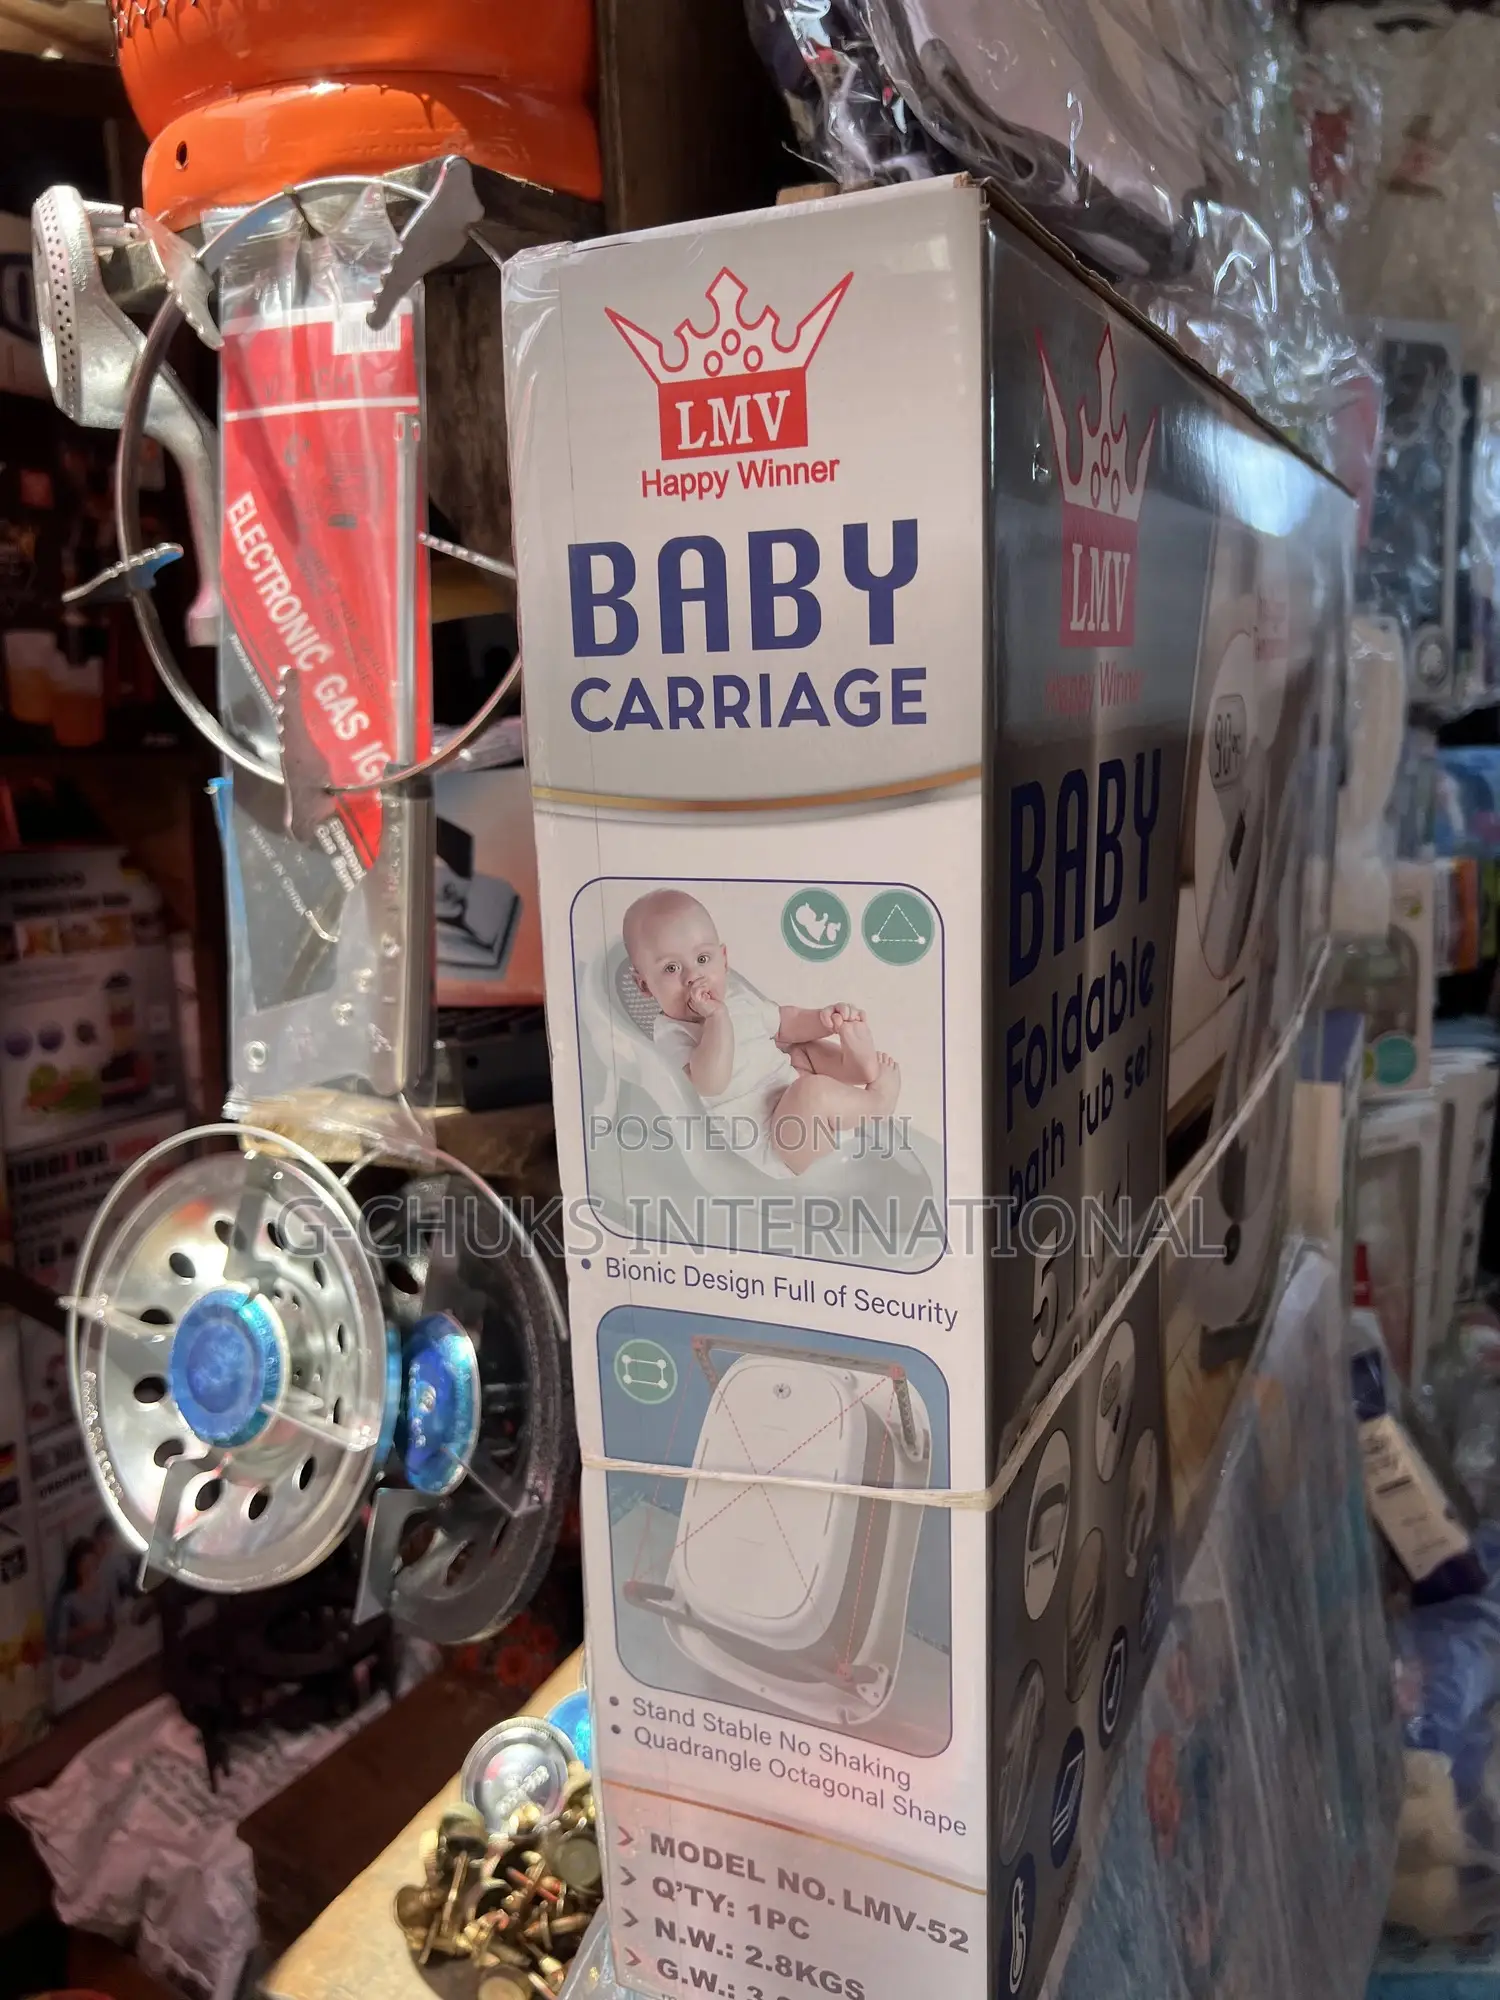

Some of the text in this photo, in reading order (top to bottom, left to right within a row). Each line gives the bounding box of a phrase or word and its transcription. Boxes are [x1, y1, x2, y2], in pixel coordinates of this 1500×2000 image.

[675, 389, 791, 452] LMV
[642, 458, 840, 501] Happy Winner
[568, 518, 918, 657] BABY
[1069, 542, 1132, 633] LMV
[226, 491, 335, 672] ELECTRONIC
[314, 672, 369, 741] GAS
[350, 739, 392, 783] IG
[570, 667, 927, 733] CARRIAGE
[1009, 748, 1162, 988] BABY
[1006, 935, 1156, 1134] Foldable
[1008, 1025, 1153, 1230] bath tub set
[605, 1257, 958, 1332] Bionic Design Full of Security
[632, 1697, 911, 1791] Stand Stable No Shaking
[634, 1726, 967, 1836] Quadrangle Octagonal Shape
[650, 1833, 766, 1884] MODEL
[654, 1917, 866, 2000] N.W.: 2.8KGS
[747, 1903, 811, 1940] 1PC
[656, 1957, 735, 2000] G.W.:
